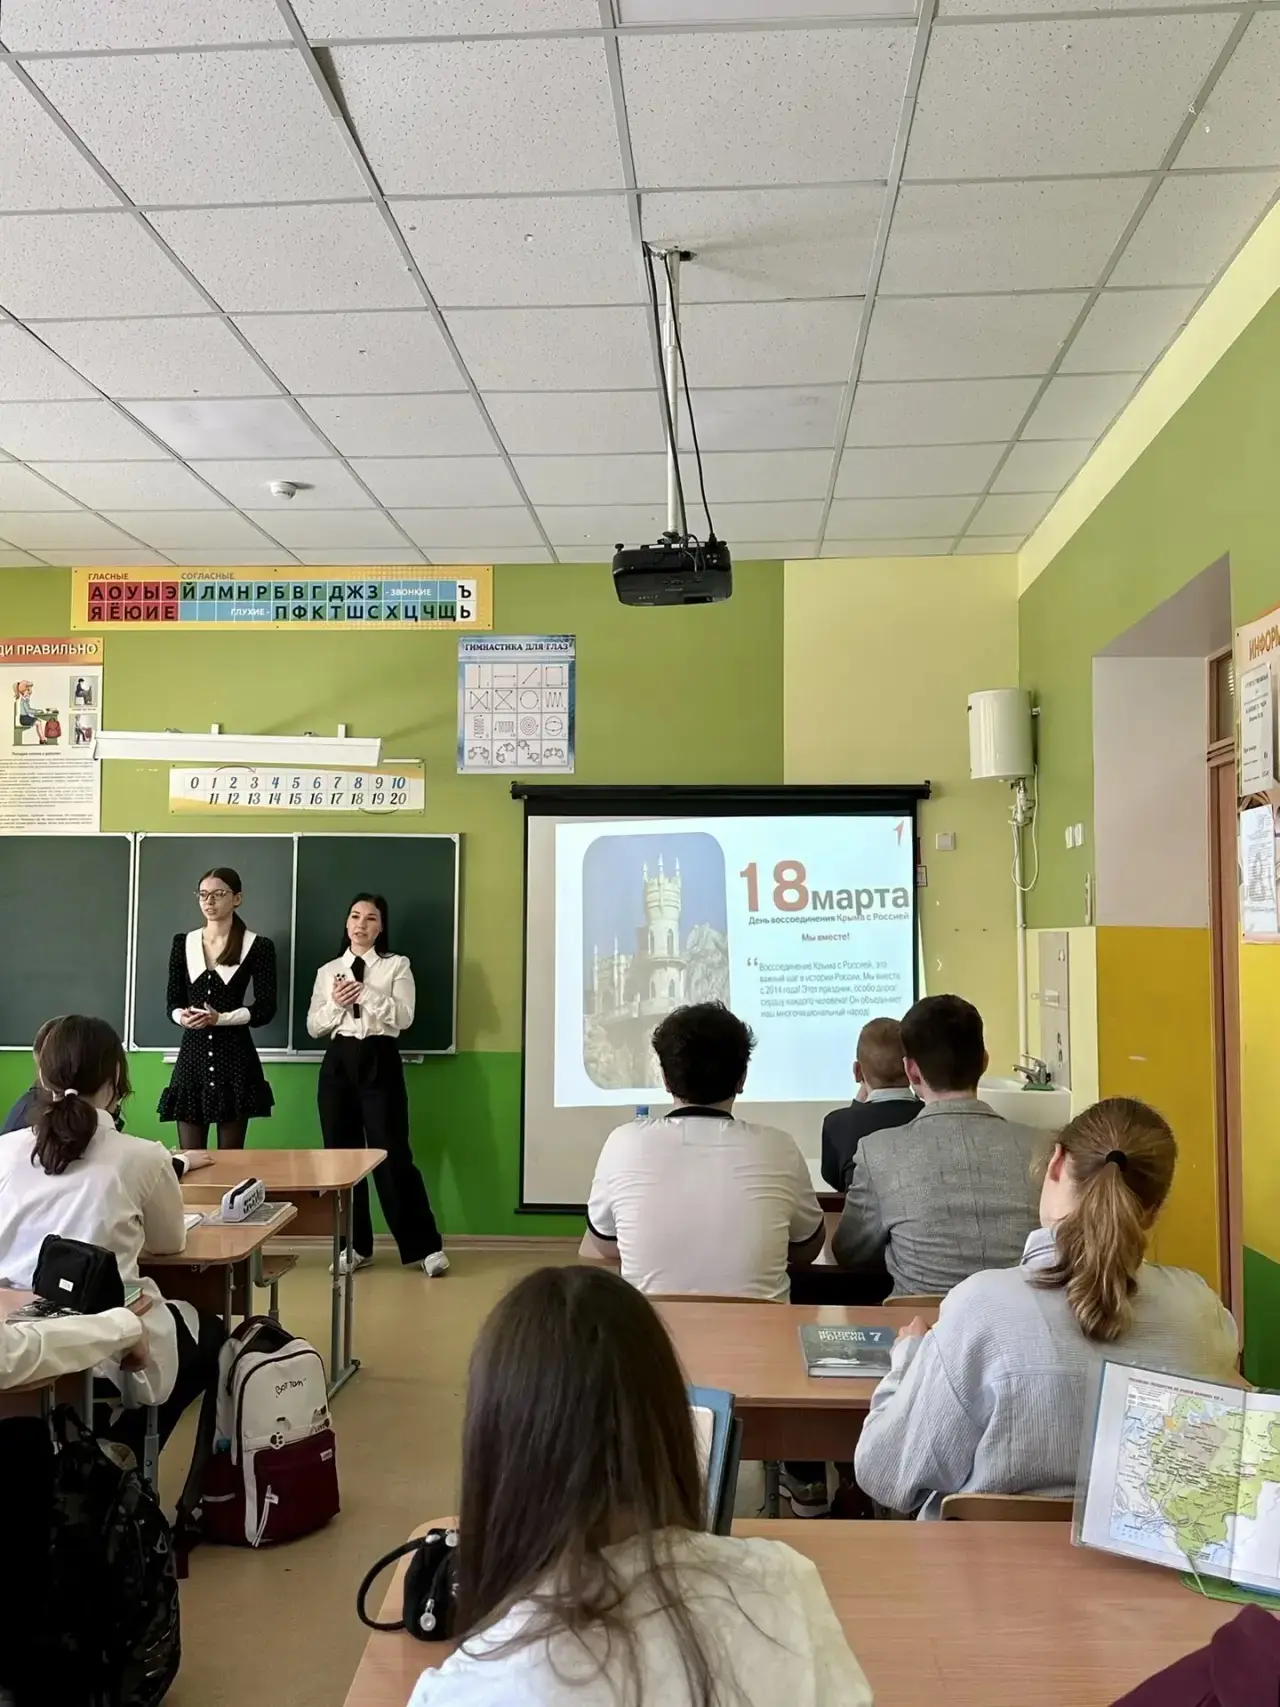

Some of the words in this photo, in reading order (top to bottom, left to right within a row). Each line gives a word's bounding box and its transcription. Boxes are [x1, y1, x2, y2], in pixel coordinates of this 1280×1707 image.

[181, 572, 235, 580] СОГЛАСНЫЕ
[390, 588, 432, 596] ЗВОНКИЕ
[230, 608, 265, 616] ГЛУХИЕ
[17, 644, 98, 655] ПРАВИЛЬНО
[465, 643, 522, 651] ГИМНАСТИКА
[525, 643, 544, 651] ДЛЯ
[190, 777, 199, 789] 0
[212, 777, 217, 789] 1
[230, 777, 237, 789] 2
[250, 777, 258, 789] 3
[272, 777, 279, 789] 4
[292, 777, 300, 789] 5
[313, 777, 321, 789] 6
[334, 777, 342, 789] 7
[354, 777, 362, 789] 8
[375, 777, 383, 789] 9
[392, 777, 406, 789] 10
[209, 793, 219, 804] 11
[228, 793, 239, 804] 12
[248, 793, 260, 804] 13
[269, 793, 281, 804] 14
[289, 793, 302, 804] 15
[310, 793, 323, 804] 16
[331, 793, 343, 804] 17
[351, 793, 364, 804] 18
[372, 793, 384, 804] 19
[390, 793, 406, 804] 20
[740, 860, 809, 912] 18
[812, 886, 910, 915] марта
[748, 916, 770, 925] День
[771, 915, 836, 924] воссоединения
[836, 914, 865, 923] Крыма
[873, 912, 909, 921] Россией
[802, 933, 816, 941] Мы
[817, 932, 850, 941] вместе!
[869, 1331, 882, 1341] 7
